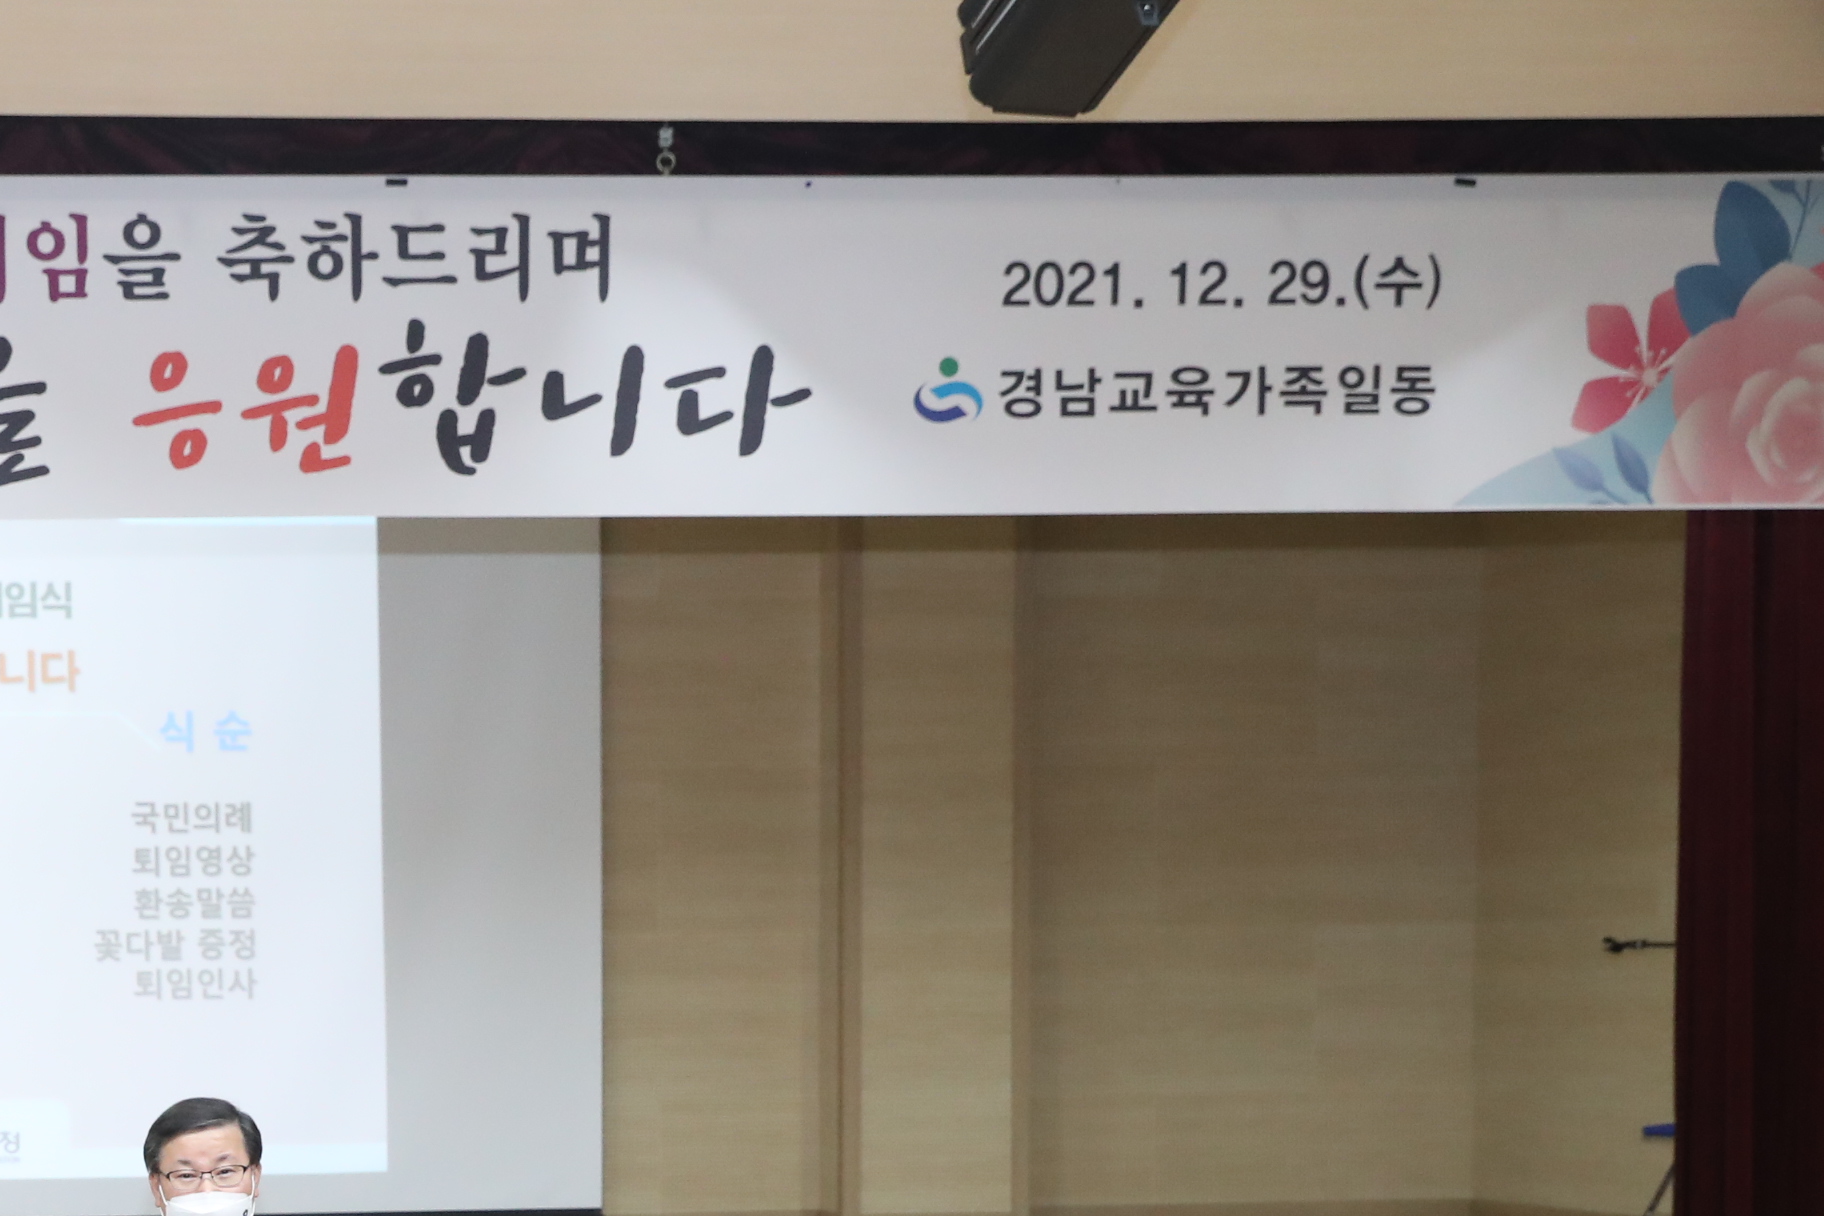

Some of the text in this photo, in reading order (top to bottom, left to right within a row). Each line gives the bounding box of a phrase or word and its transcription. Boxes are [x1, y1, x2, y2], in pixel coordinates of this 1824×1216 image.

[217, 212, 611, 302] 축하드리며
[1003, 254, 1441, 309] 2021. 12. 29.(수)
[133, 318, 812, 476] 응원합니다
[1000, 364, 1435, 418] 경남교육가족일동
[132, 802, 252, 834] 국민의례
[133, 845, 255, 878] 퇴임영상
[135, 887, 256, 920] 환송말씀
[95, 928, 256, 962] 꽃다발 증정
[134, 966, 257, 1000] 퇴임인사
